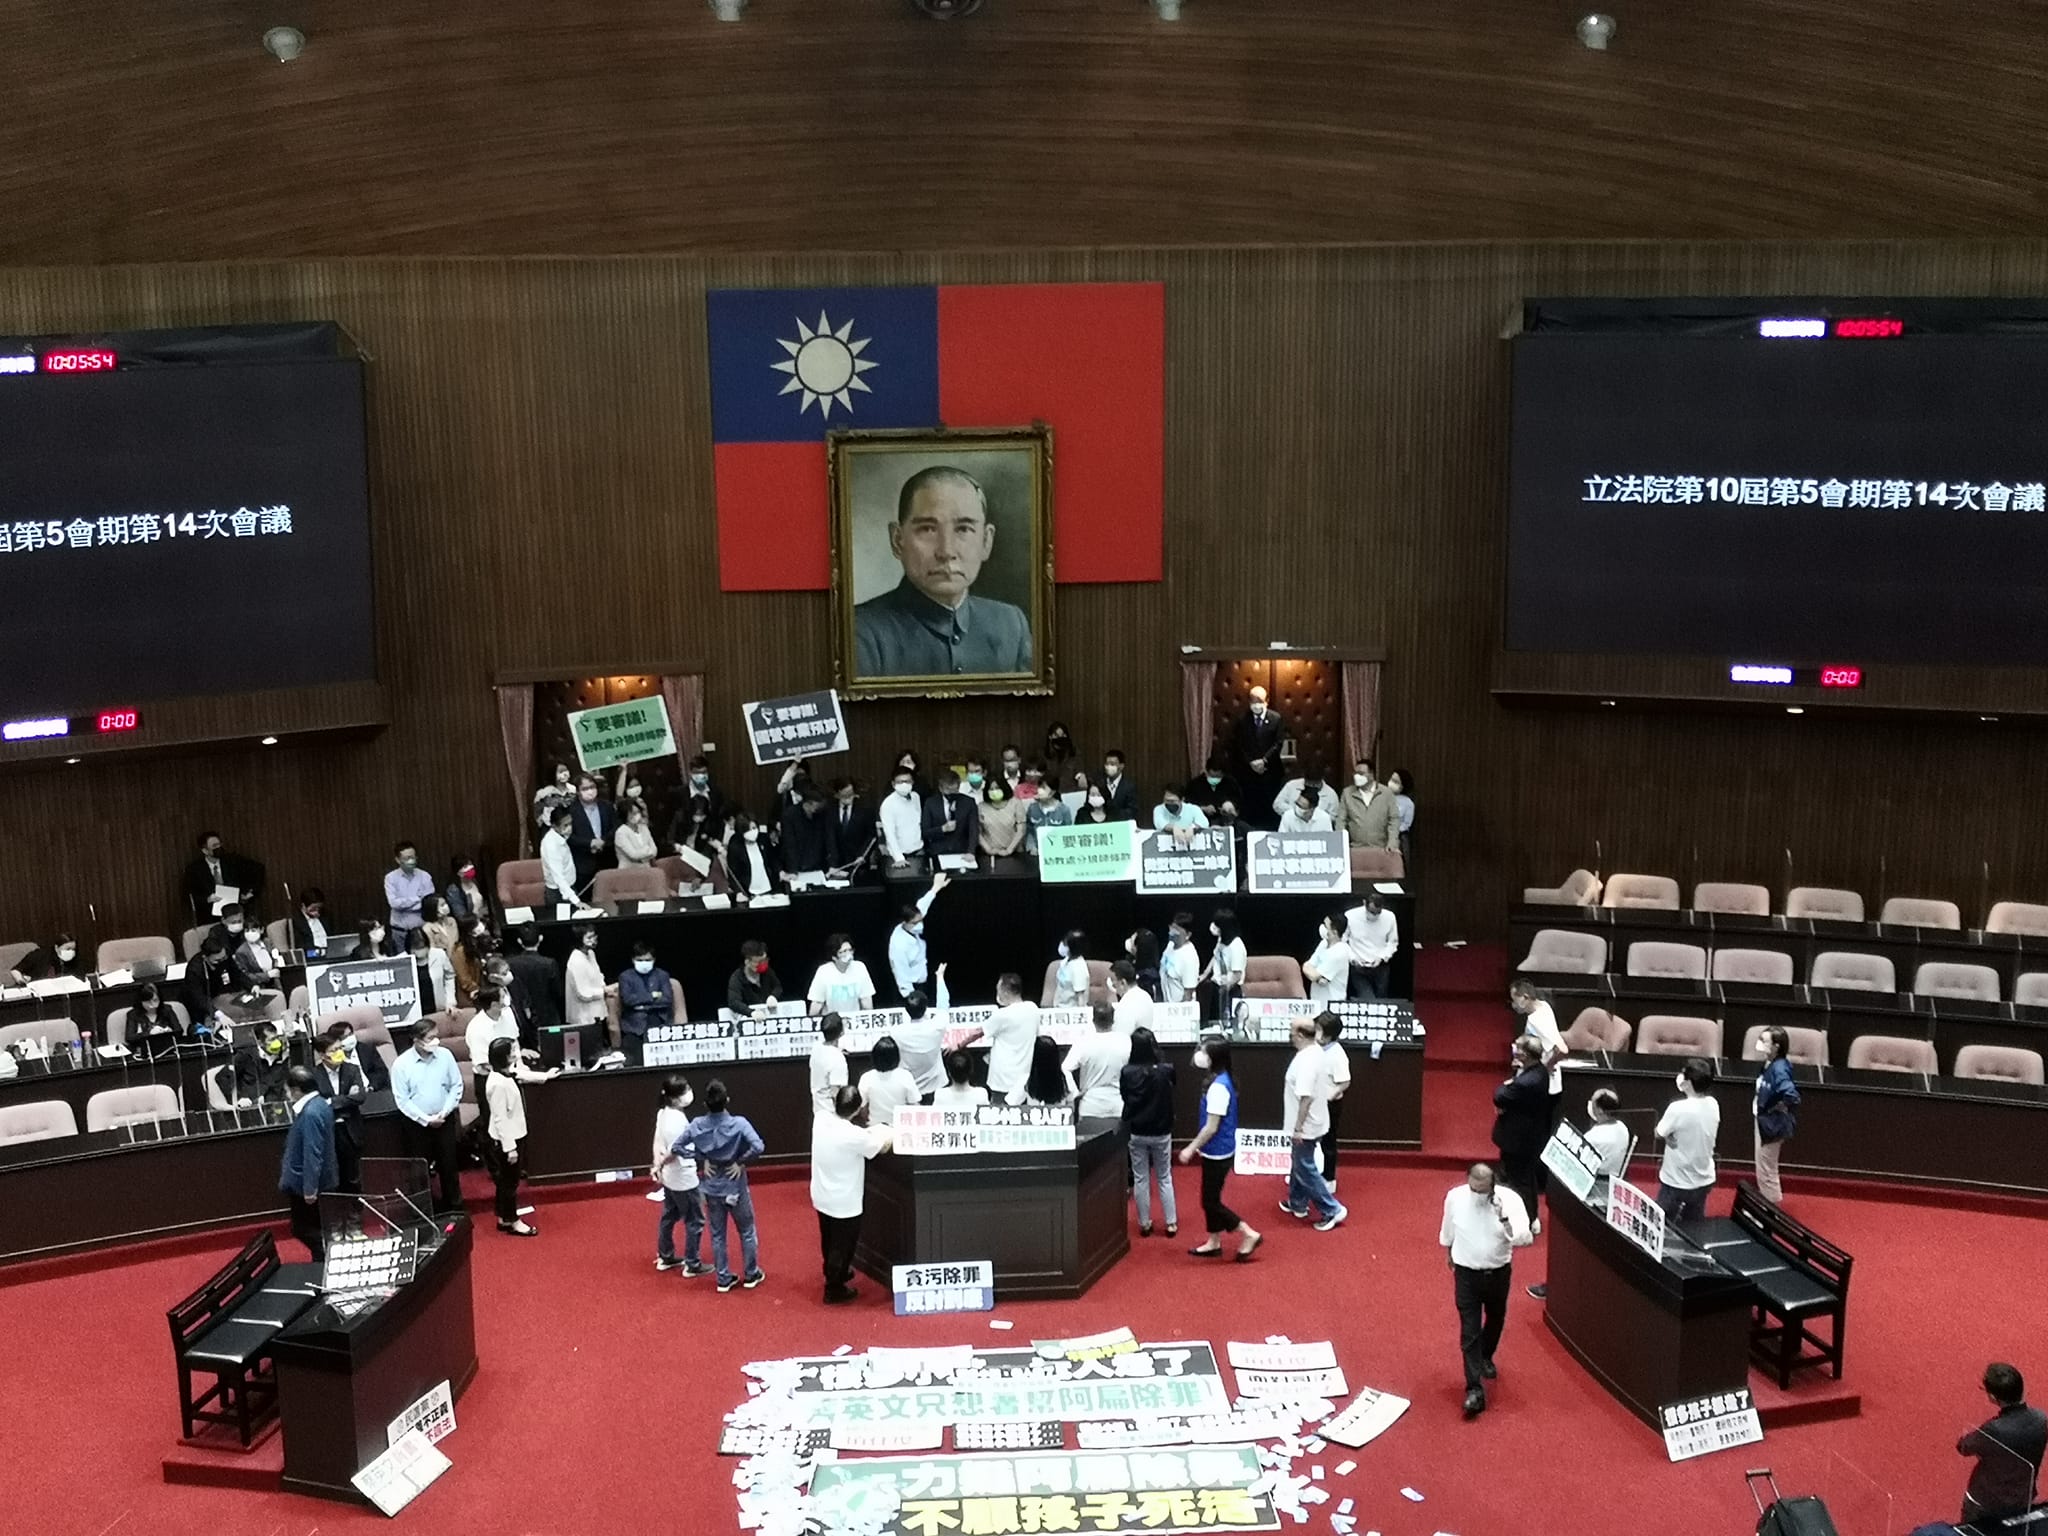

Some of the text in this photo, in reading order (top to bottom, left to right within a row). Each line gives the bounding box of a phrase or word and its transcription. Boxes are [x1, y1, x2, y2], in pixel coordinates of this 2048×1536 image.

[47, 353, 113, 370] 10:05:54
[1582, 473, 2046, 513] 立法院第10屆第5會期第14次會議
[100, 713, 136, 729] 0:00
[905, 1265, 981, 1288] 貪污除罪
